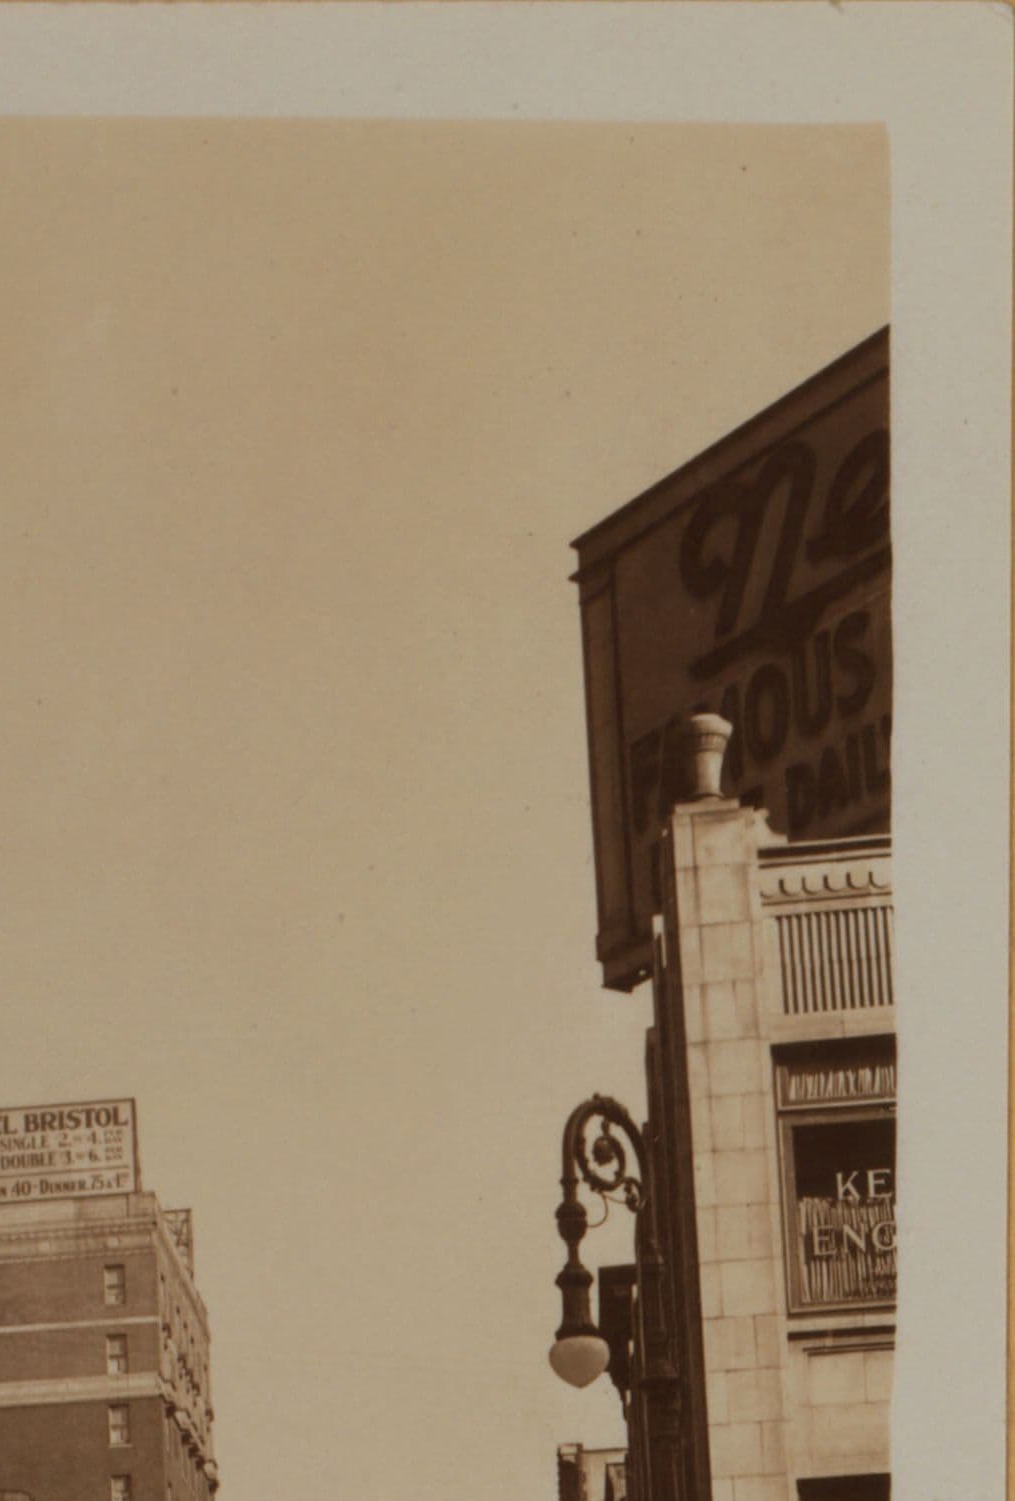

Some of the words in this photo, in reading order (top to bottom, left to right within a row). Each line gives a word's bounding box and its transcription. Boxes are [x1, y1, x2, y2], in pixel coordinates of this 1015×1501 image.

[23, 1105, 129, 1133] BRISTOL
[0, 1134, 50, 1152] SINGLE
[0, 1150, 56, 1171] DOUBLE
[39, 1177, 87, 1196] DINNER
